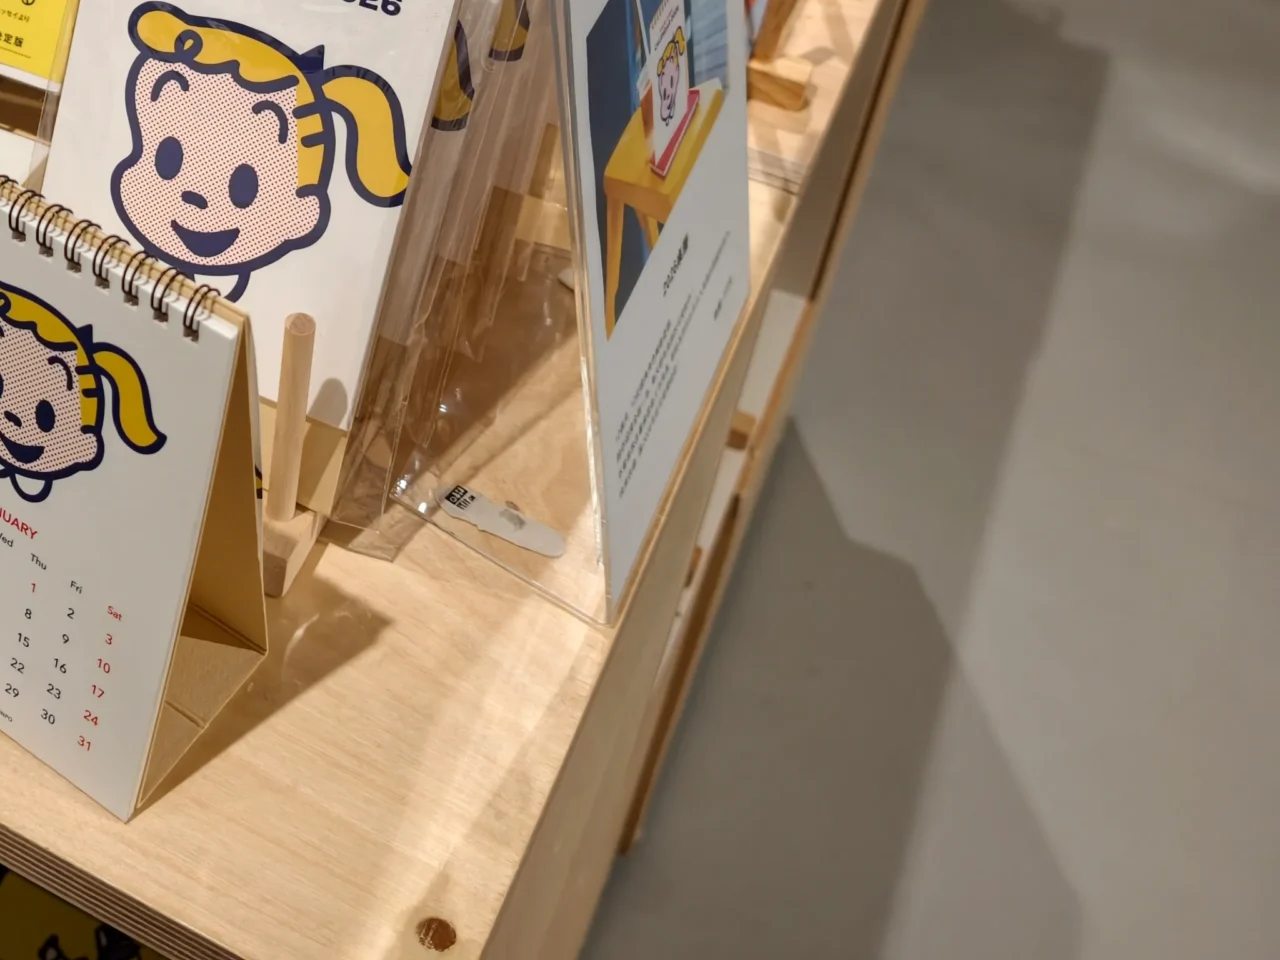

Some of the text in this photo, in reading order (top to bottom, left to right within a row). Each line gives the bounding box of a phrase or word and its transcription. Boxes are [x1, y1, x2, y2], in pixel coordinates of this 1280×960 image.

[30, 554, 47, 570] Thu
[70, 580, 82, 594] Fri
[107, 605, 123, 621] Sat
[30, 583, 113, 645] 1 2 3
[17, 633, 30, 647] 15
[53, 659, 67, 673] 16
[91, 685, 105, 698] 17
[24, 609, 31, 620] 8
[62, 634, 69, 644] 9
[97, 658, 110, 673] 10
[5, 684, 19, 698] 29
[41, 709, 55, 725] 30
[77, 736, 91, 751] 31
[10, 658, 24, 673] 22
[47, 684, 61, 699] 23
[83, 710, 98, 726] 24
